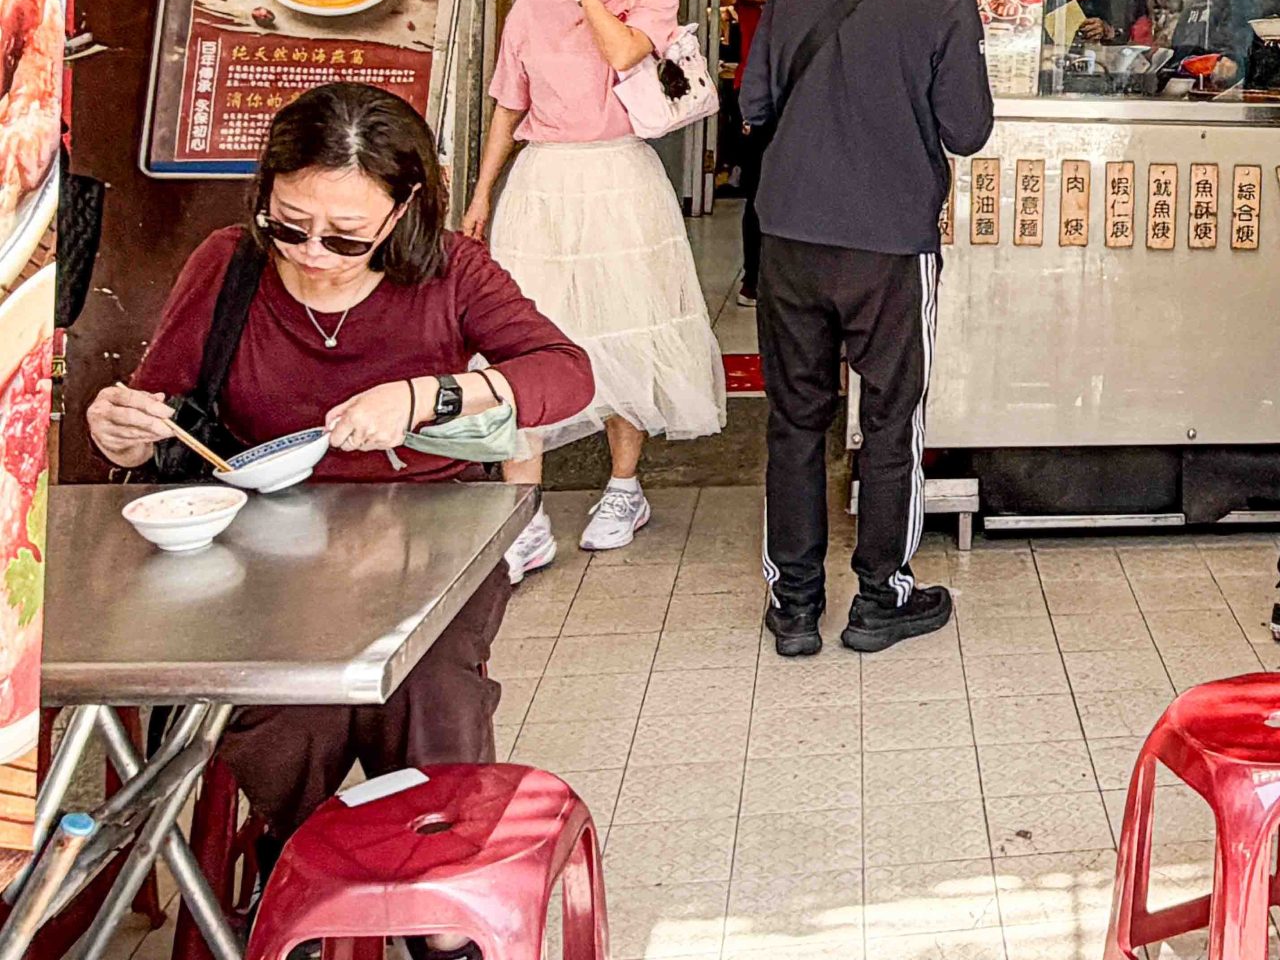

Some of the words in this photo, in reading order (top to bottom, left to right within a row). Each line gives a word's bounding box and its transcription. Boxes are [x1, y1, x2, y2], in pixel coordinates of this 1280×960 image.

[231, 45, 366, 65] 純天然的海燕窩
